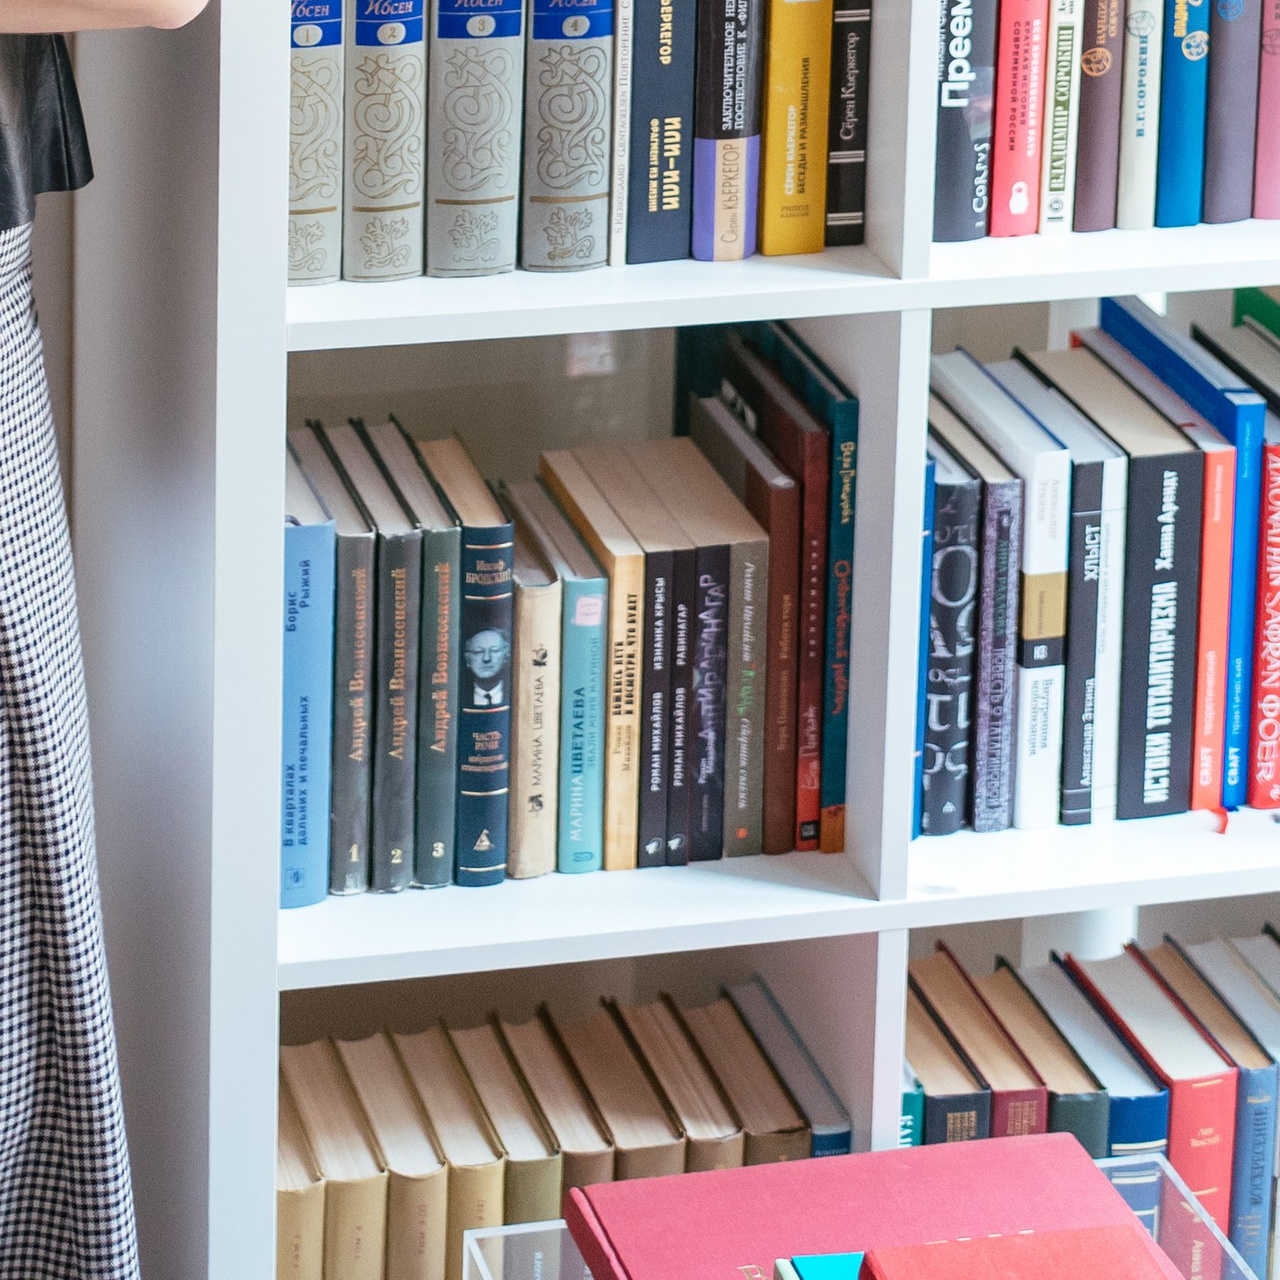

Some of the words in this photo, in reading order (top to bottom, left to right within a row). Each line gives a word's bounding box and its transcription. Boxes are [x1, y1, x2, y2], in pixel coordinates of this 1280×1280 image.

[388, 26, 397, 39] 2
[477, 18, 485, 31] 3
[571, 19, 580, 31] 4
[1021, 21, 1031, 71] КРАТКАЯ
[722, 21, 735, 131] ЗАКЛЮЧИТЕЛЬНОЕ
[734, 42, 747, 129] ПОСЛЕСЛОВИЕ
[841, 33, 859, 97] Кьеркегор
[1010, 21, 1021, 103] СОВРЕМЕННОЙ
[1054, 29, 1073, 101] СОРОКИН
[798, 58, 811, 139] РАЗМЫШЛЕНИЯ
[839, 99, 857, 140] Сёрен
[1019, 74, 1028, 126] ИСТОРИЯ
[649, 118, 659, 165] ФРАГМЕНТ
[784, 105, 797, 161] КЬЕРКЕГОР
[798, 143, 808, 152] И
[1008, 107, 1017, 151] РОССИИ
[1050, 105, 1070, 188] ВЛАДИМИР
[648, 183, 658, 211] ЖИЗНИ
[649, 168, 658, 180] ИЗ
[720, 143, 740, 210] КЬЕРКЕГОР
[797, 155, 808, 194] БЕСЕДЫ
[720, 212, 738, 243] Сёрен
[1157, 470, 1180, 524] Арендт
[1084, 524, 1101, 581] ХЛЫСТ
[1155, 525, 1176, 571] Ханна
[299, 559, 311, 608] Рыжий
[627, 592, 639, 624] БУДЕТ
[654, 577, 666, 616] КРЫСЫ
[287, 592, 298, 632] Борис
[389, 567, 408, 690] Вознесенский
[432, 562, 451, 684] Вознесенский
[626, 628, 637, 646] ЧТО
[675, 603, 688, 665] РАВИНАГАР
[653, 619, 665, 670] ИЗНАНКА
[1147, 581, 1178, 729] ТОТАЛИТАРИЗМА
[431, 690, 449, 753] Андрей
[532, 676, 545, 730] ЦВЕТАЕВА
[649, 692, 663, 751] МИХАЙЛОВ
[673, 687, 687, 746] МИХАЙЛОВ
[1082, 678, 1095, 722] Эткинд
[298, 696, 310, 772] печальных
[349, 697, 367, 761] Андрей
[389, 695, 407, 760] Андрей
[571, 687, 586, 774] ЦВЕТАЕВА
[531, 735, 543, 786] МАРИНА
[650, 754, 662, 791] РОМАН
[673, 749, 685, 786] РОМАН
[1079, 724, 1094, 786] Александр
[1143, 732, 1171, 803] ИСТОКИ
[1199, 746, 1214, 786] CRAFT
[1228, 746, 1241, 786] CRAFT
[285, 764, 296, 835] кварталах
[297, 787, 309, 845] дальних
[571, 775, 585, 840] МАРИНА
[284, 839, 294, 847] В
[349, 844, 359, 861] 1
[392, 849, 404, 863] 2
[433, 842, 445, 858] 3
